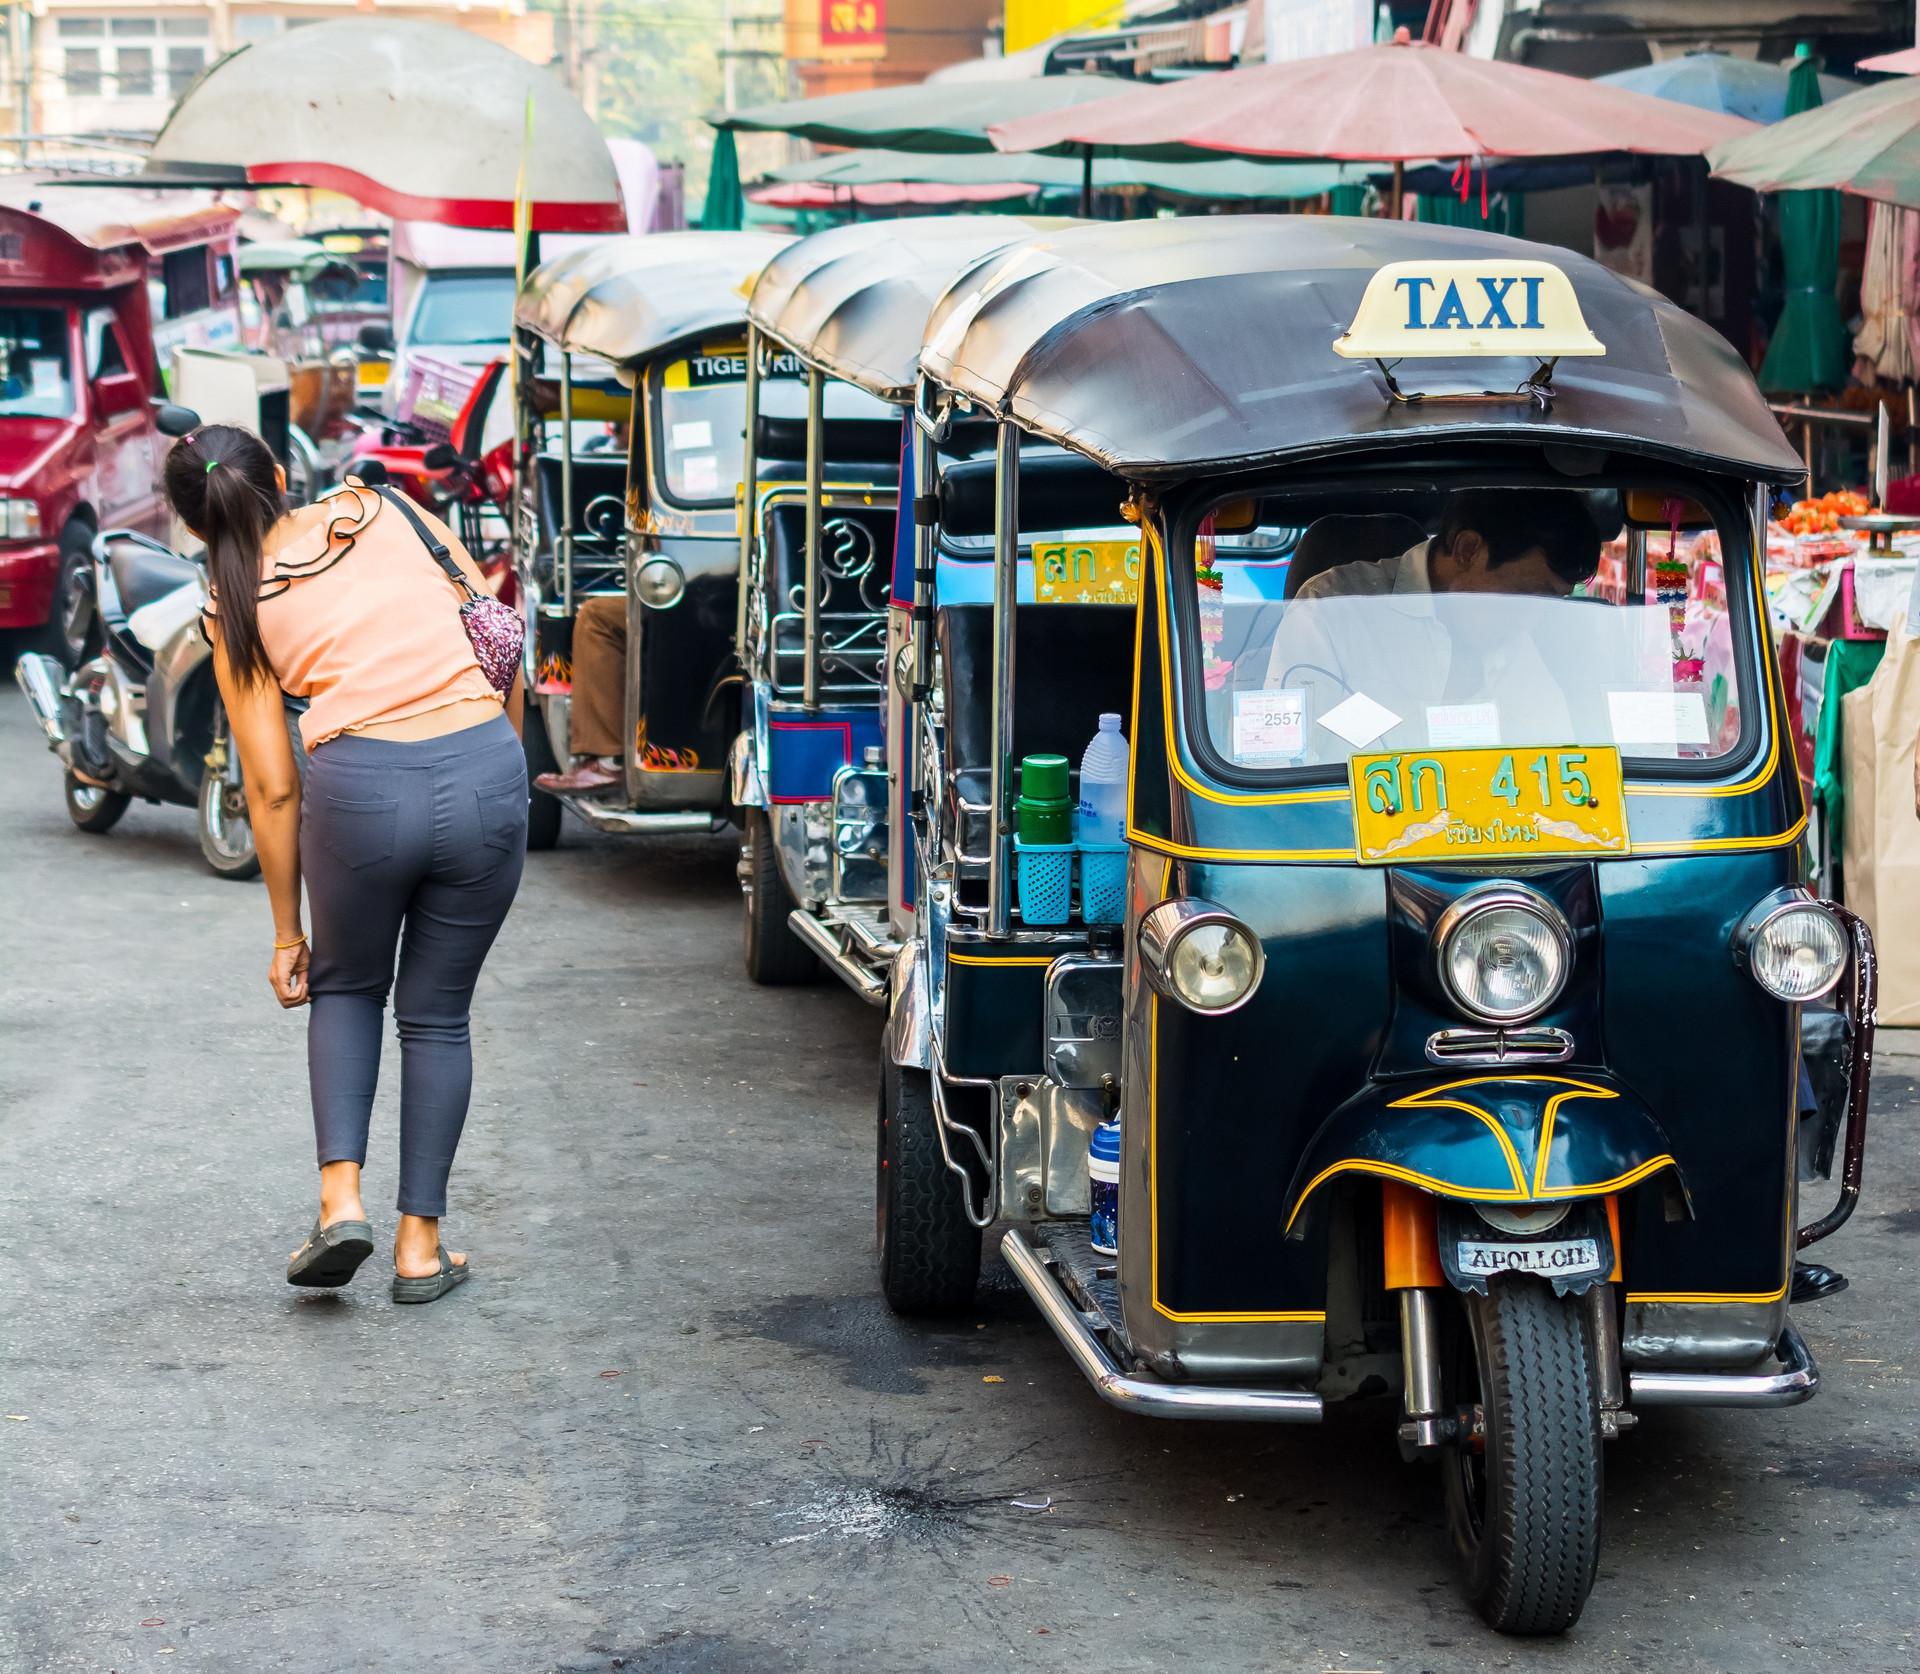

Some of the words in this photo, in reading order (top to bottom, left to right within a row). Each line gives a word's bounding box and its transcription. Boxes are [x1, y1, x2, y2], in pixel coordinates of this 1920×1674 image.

[1394, 277, 1545, 330] TAXI
[692, 357, 748, 376] TIGE
[773, 354, 809, 372] KIN
[1044, 546, 1096, 583] สก
[1124, 546, 1140, 580] 6
[1265, 712, 1302, 727] 2557
[1365, 756, 1448, 814] สก
[1489, 754, 1592, 807] 415
